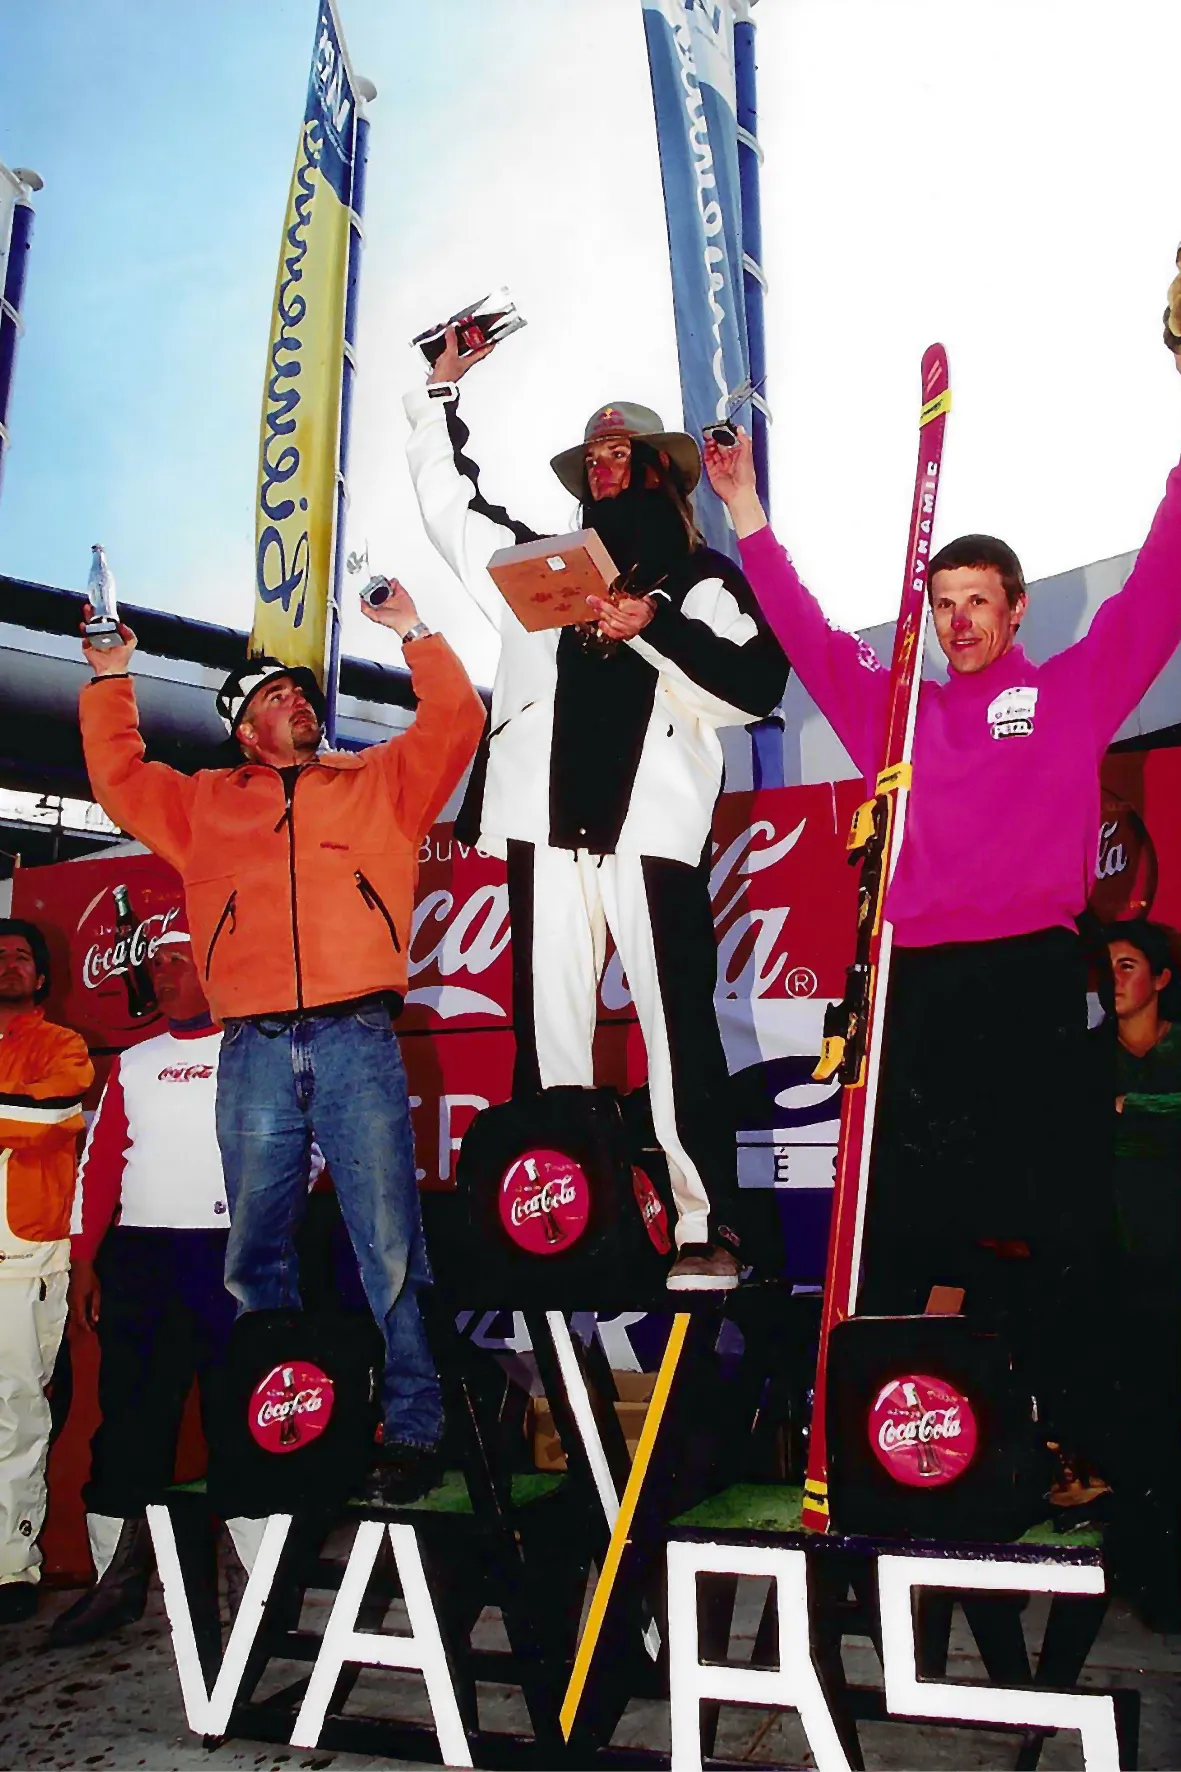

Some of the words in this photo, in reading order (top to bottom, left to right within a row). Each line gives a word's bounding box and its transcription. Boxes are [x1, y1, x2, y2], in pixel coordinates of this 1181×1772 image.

[911, 460, 939, 592] DYNAMIC
[510, 1175, 577, 1226] Coca-Cola
[878, 1405, 962, 1452] Coca-Cola
